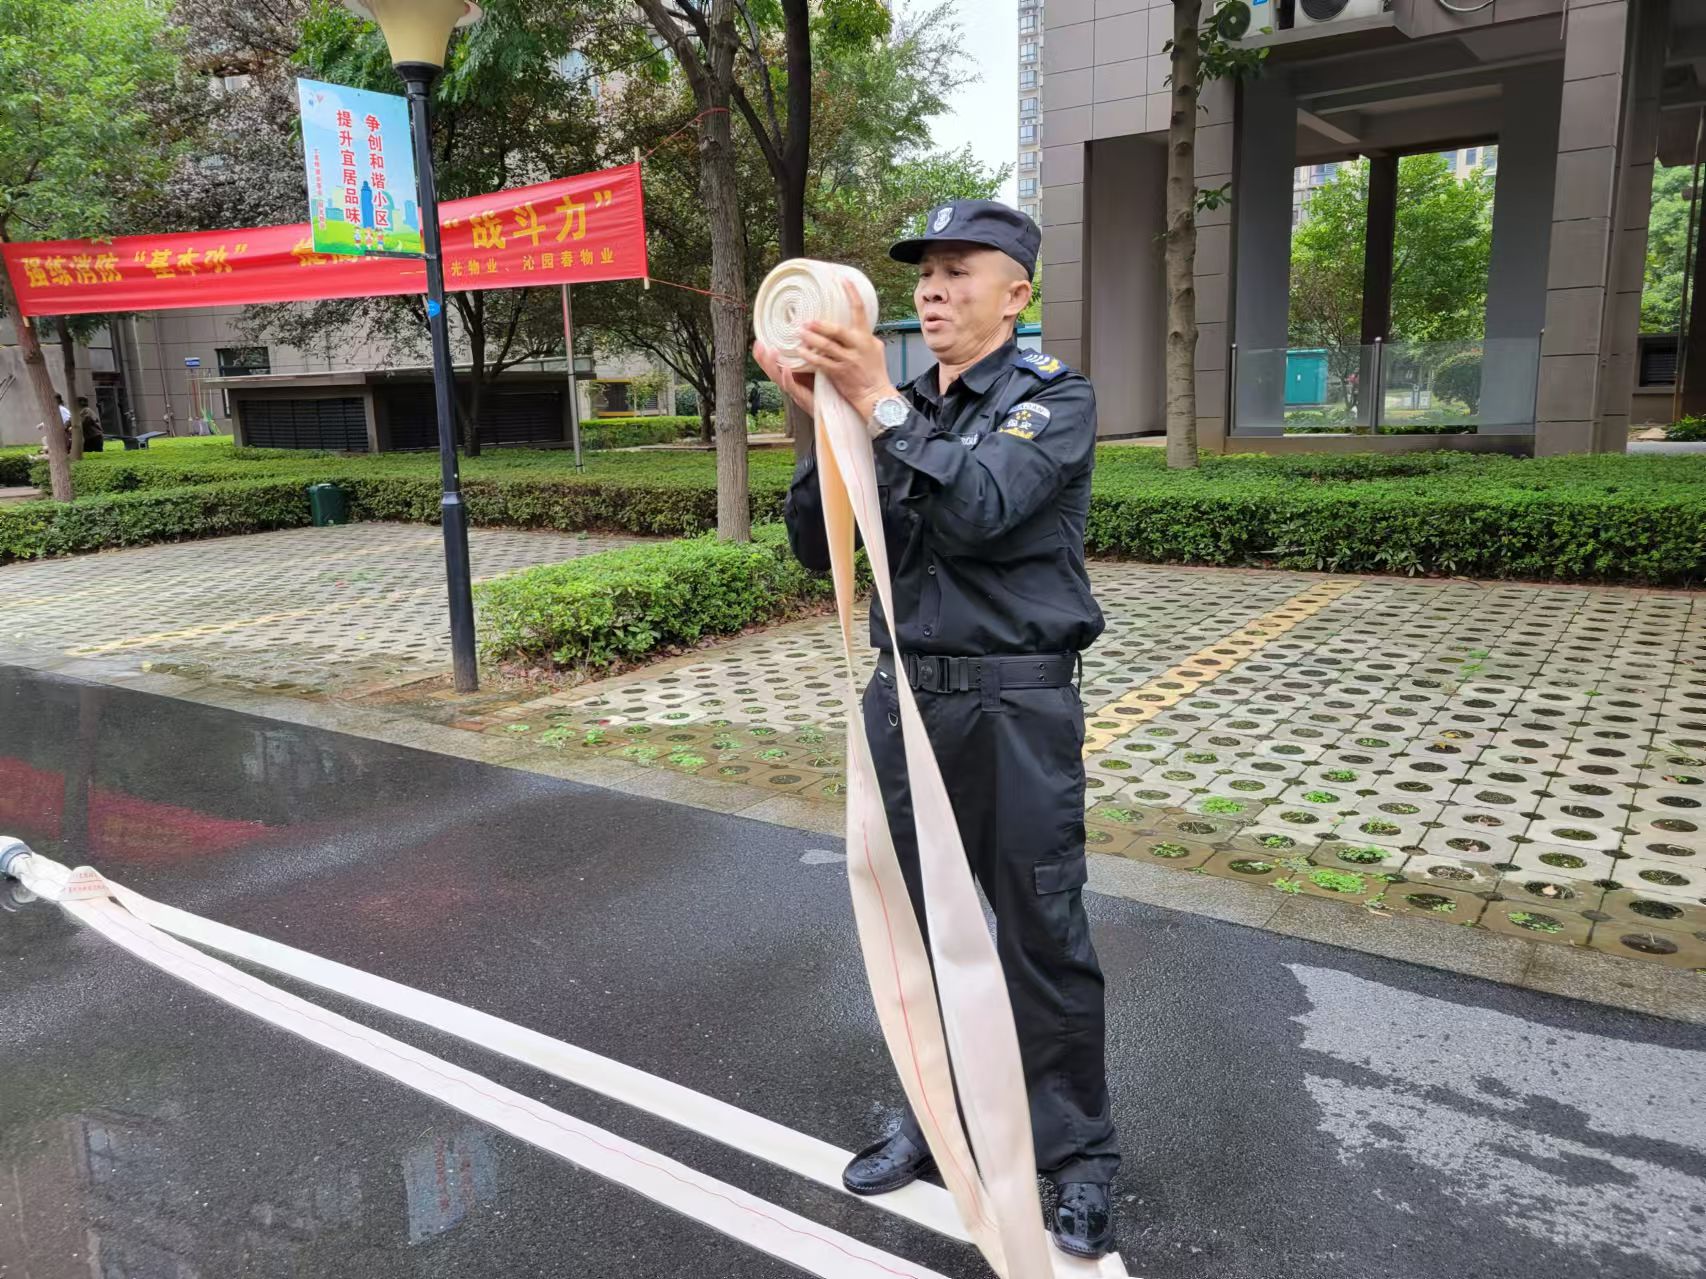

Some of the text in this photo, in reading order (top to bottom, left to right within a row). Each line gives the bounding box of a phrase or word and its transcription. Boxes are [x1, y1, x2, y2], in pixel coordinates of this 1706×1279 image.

[337, 109, 360, 224] 提升宜居品味
[365, 114, 389, 226] 争创和谐小区
